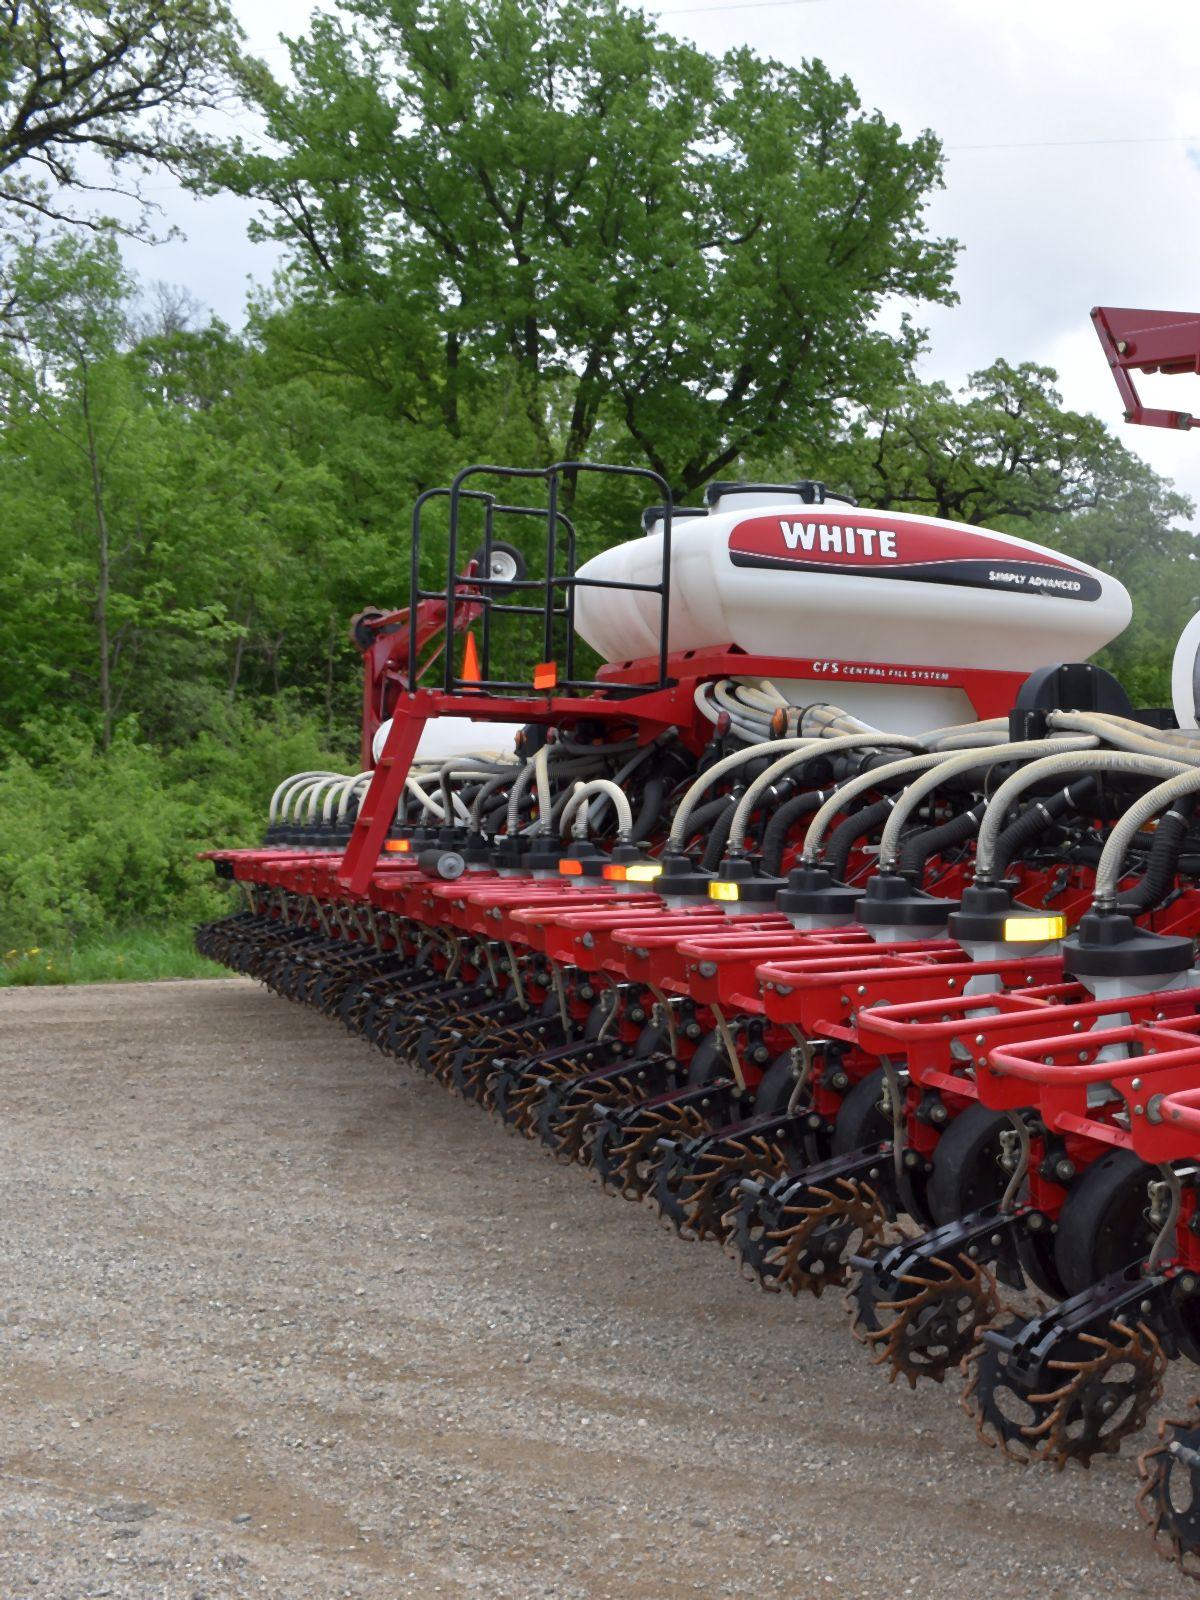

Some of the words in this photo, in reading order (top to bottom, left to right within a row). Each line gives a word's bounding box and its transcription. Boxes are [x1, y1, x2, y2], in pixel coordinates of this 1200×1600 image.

[779, 521, 898, 558] WHITE
[988, 570, 1026, 585] SIMPLY
[1028, 575, 1081, 592] ADVANCED
[812, 661, 839, 674] CFS
[842, 666, 885, 677] CENTRAL
[888, 669, 908, 678] FILL
[911, 670, 949, 680] SYSTEM
